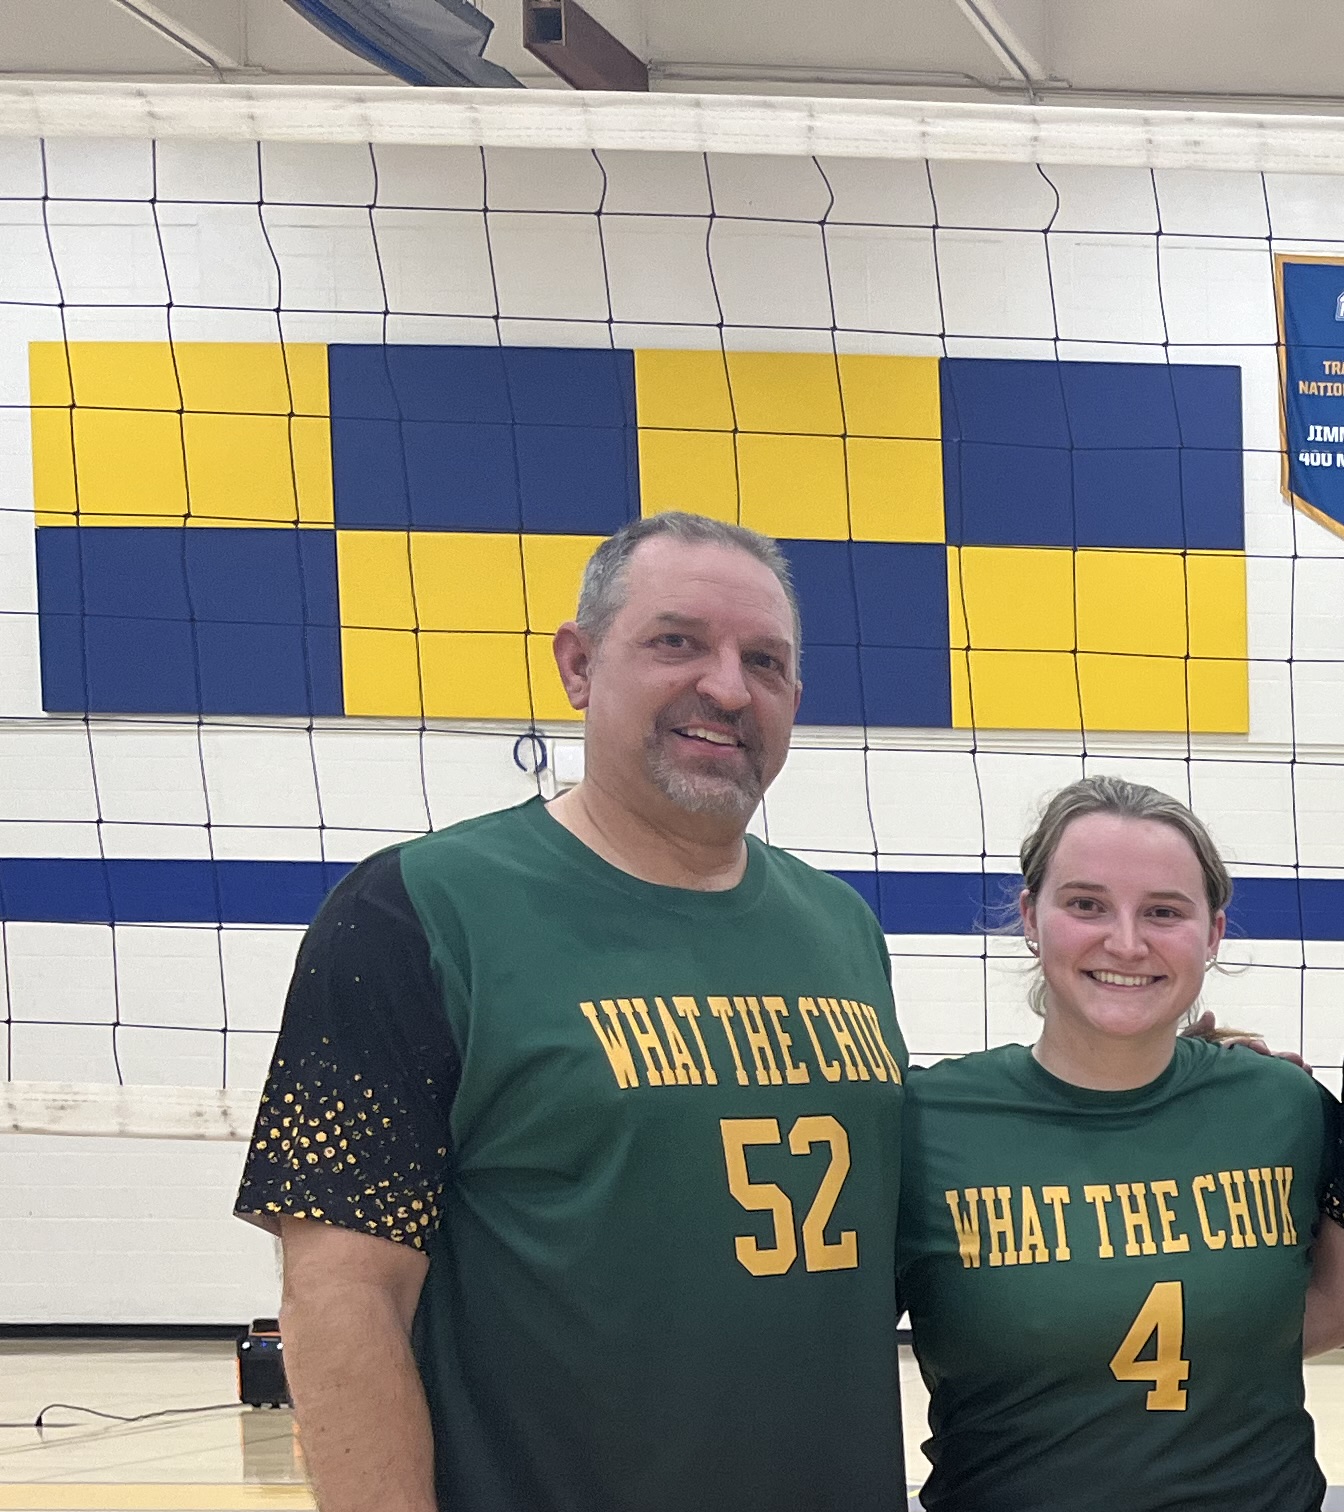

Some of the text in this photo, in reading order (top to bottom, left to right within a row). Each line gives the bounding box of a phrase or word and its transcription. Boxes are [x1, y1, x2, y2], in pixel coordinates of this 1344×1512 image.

[1299, 450, 1332, 467] 400
[579, 996, 903, 1090] WHAT THE CHUK
[719, 1114, 859, 1277] 52
[944, 1165, 1298, 1269] WHAT THE CHUK
[1108, 1280, 1191, 1412] 4
